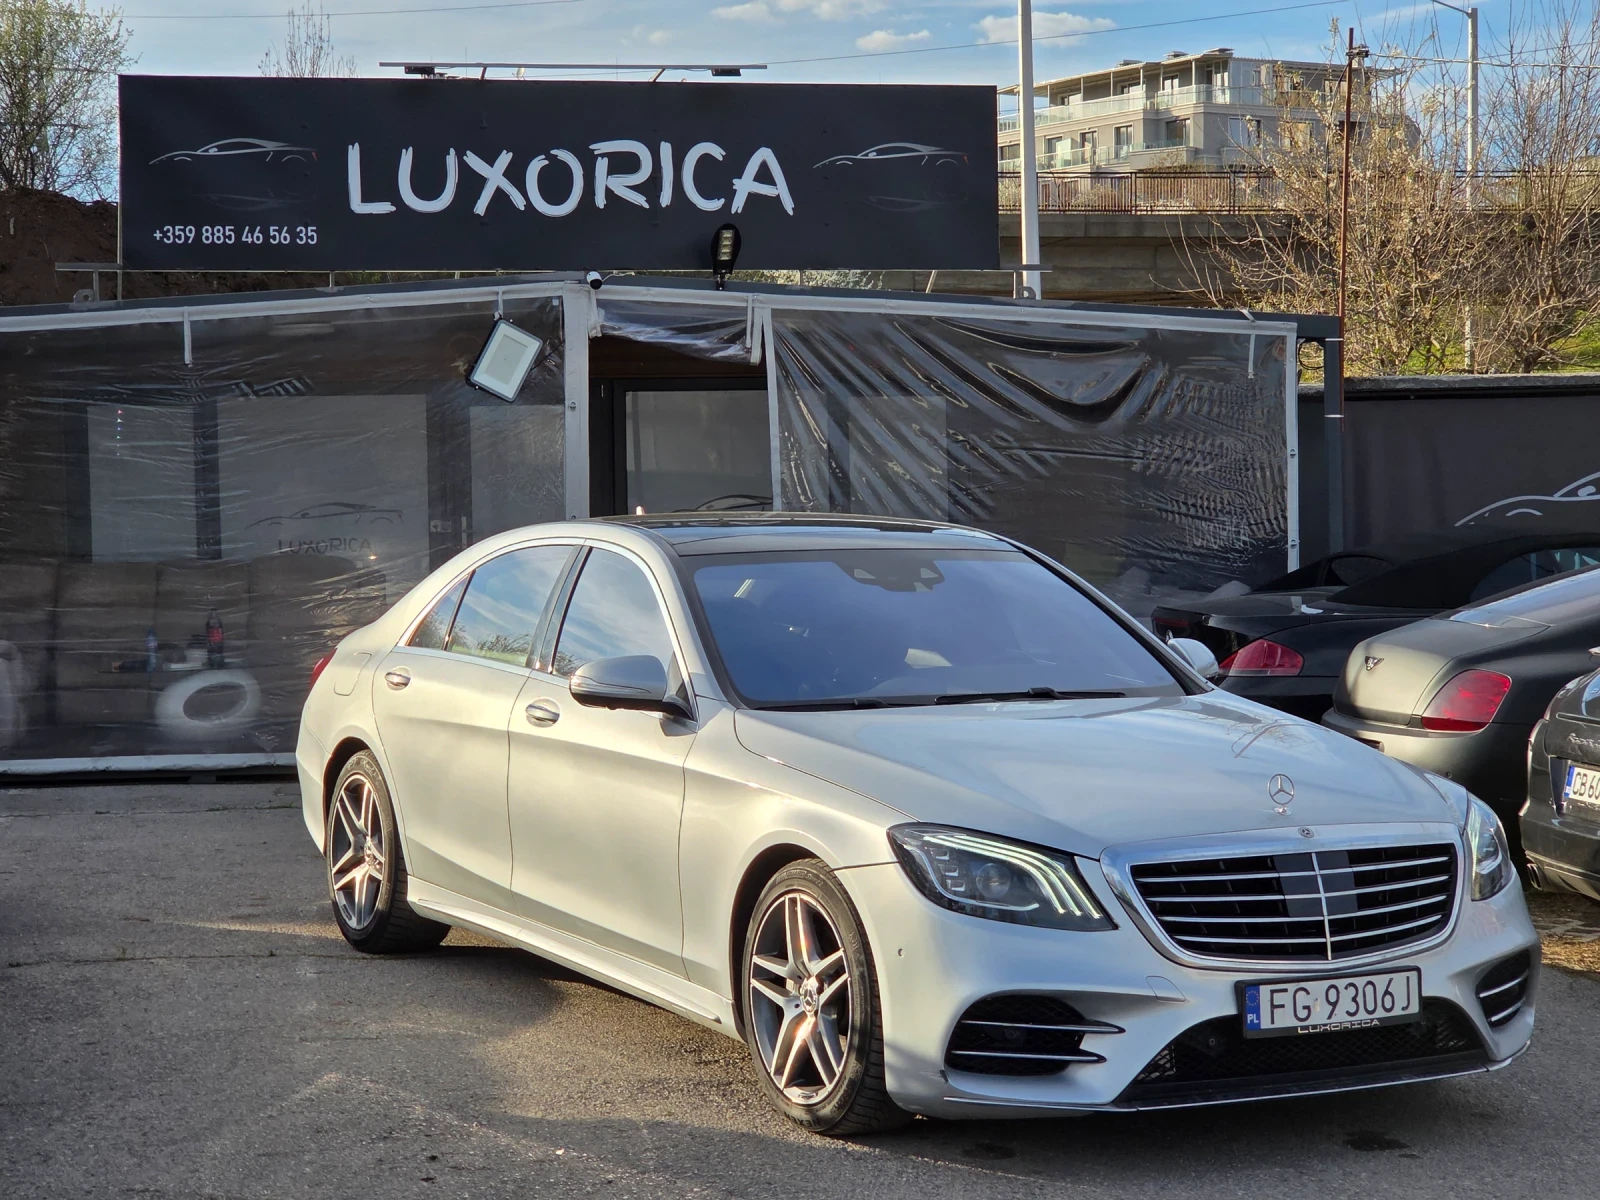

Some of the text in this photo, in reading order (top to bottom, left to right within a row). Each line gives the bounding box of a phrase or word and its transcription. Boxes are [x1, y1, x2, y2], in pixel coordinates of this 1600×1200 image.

[348, 140, 795, 217] LUXORICA
[153, 225, 318, 245] +359 885 46 56 35
[278, 537, 372, 555] LUXORICA
[1269, 975, 1411, 1025] FG 9306J
[1247, 1013, 1260, 1025] PL
[1297, 1018, 1381, 1034] LUXORICA
